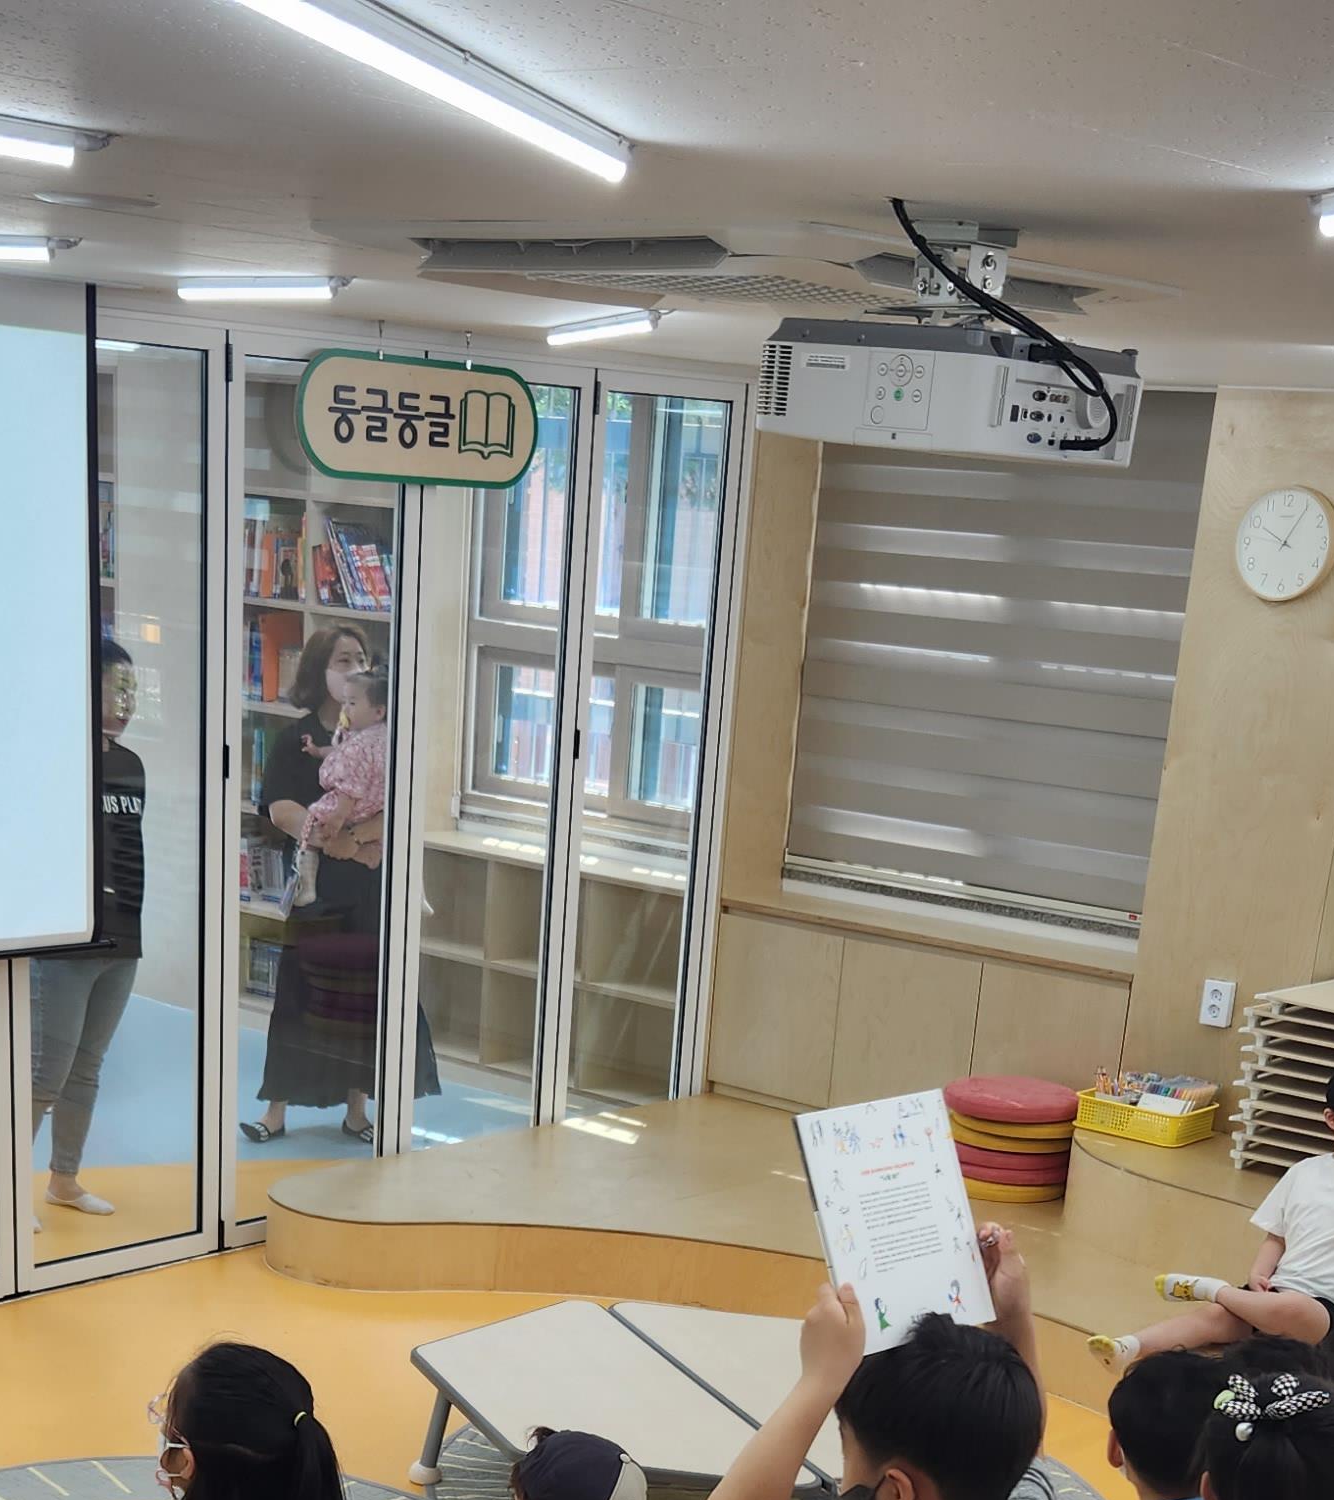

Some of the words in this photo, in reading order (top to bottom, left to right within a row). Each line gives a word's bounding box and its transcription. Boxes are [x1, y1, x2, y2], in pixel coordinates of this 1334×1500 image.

[328, 384, 456, 450] 둥글둥글
[1266, 499, 1275, 513] 11
[1283, 494, 1295, 508] 12
[1249, 515, 1262, 529] 10
[1315, 513, 1324, 529] 2
[1243, 536, 1251, 550] 9
[1319, 536, 1328, 551] 3
[1246, 556, 1256, 571] 8
[1311, 557, 1319, 569] 4
[1260, 573, 1268, 587] 7
[1276, 579, 1285, 593] 6
[1296, 573, 1305, 588] 5
